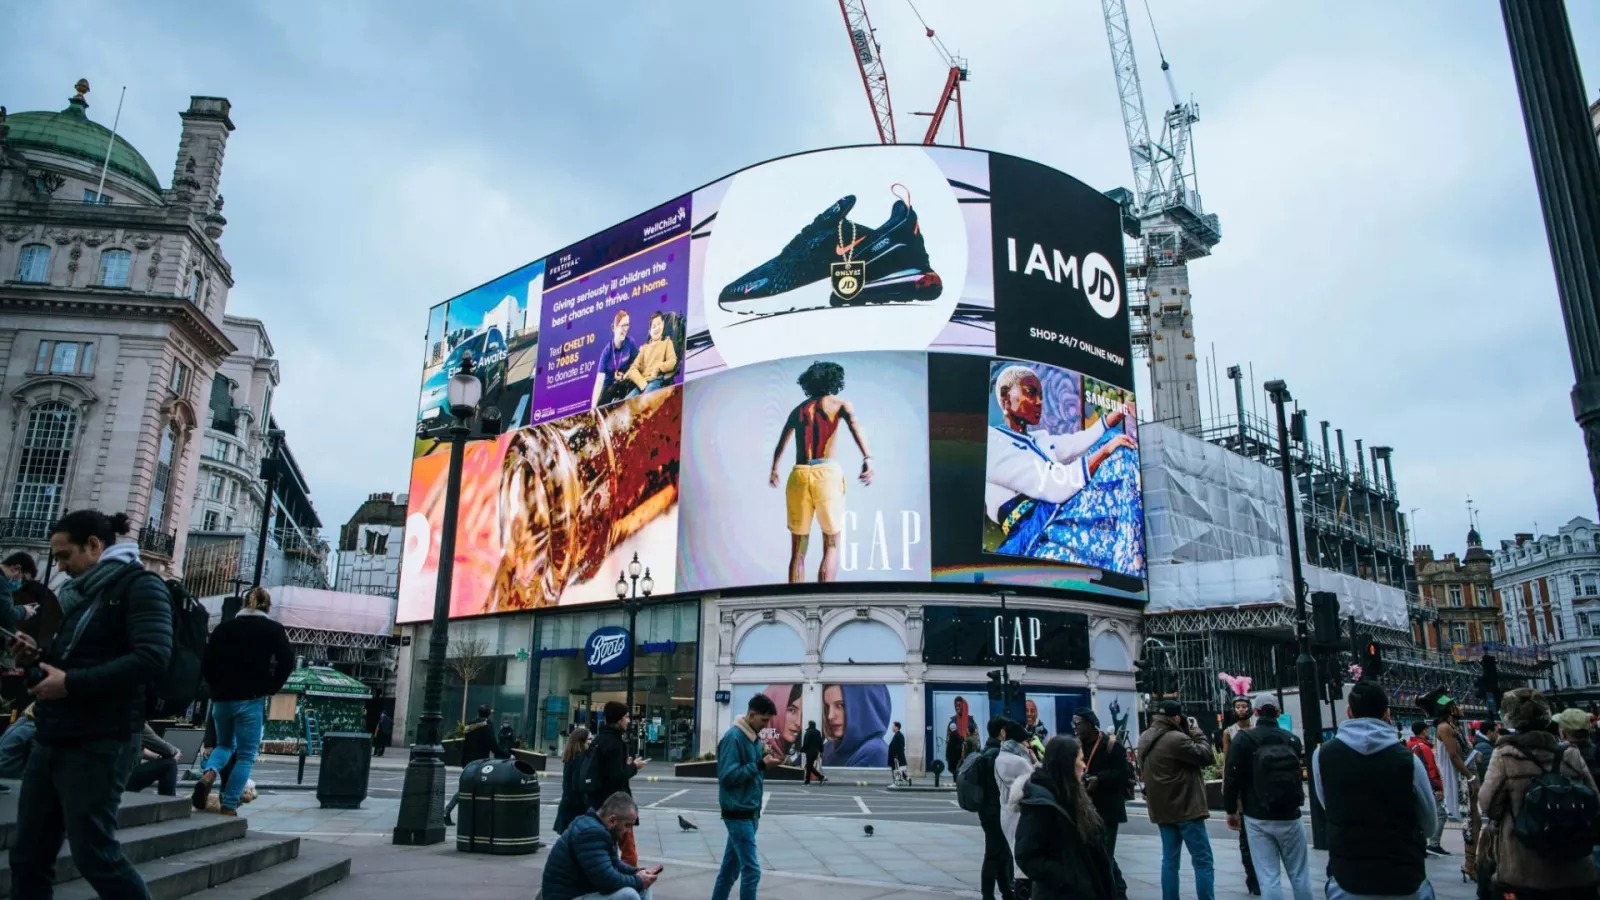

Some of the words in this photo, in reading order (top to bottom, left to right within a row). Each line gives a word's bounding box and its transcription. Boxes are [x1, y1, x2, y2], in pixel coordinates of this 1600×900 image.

[854, 32, 872, 64] WOLFF
[644, 215, 677, 236] WellChild
[560, 254, 571, 264] THE
[1008, 237, 1017, 272] I
[1024, 243, 1079, 290] AM
[1088, 266, 1115, 302] JD
[552, 314, 567, 328] best
[568, 307, 594, 320] chance
[596, 300, 604, 310] to
[606, 292, 630, 308] thrive.
[632, 285, 641, 298] At
[642, 278, 668, 294] home.
[553, 296, 576, 312] Giving
[576, 284, 609, 304] seriously
[619, 268, 650, 286] children
[652, 262, 667, 274] the
[478, 349, 508, 368] Awaits
[550, 344, 562, 357] Text
[564, 336, 586, 352] CHELT
[586, 333, 595, 344] 10
[1030, 327, 1058, 340] SHOP
[1058, 334, 1078, 348] 24/7
[1079, 341, 1106, 359] ONLINE
[1106, 352, 1124, 366] NOW
[546, 375, 554, 384] to
[554, 367, 578, 382] donate
[548, 362, 555, 371] to
[556, 352, 579, 368] 70085
[1085, 390, 1128, 416] SAMSUNG
[1034, 460, 1085, 492] you
[840, 510, 920, 572] GAP
[588, 634, 626, 666] Boots
[994, 616, 1040, 656] GAP
